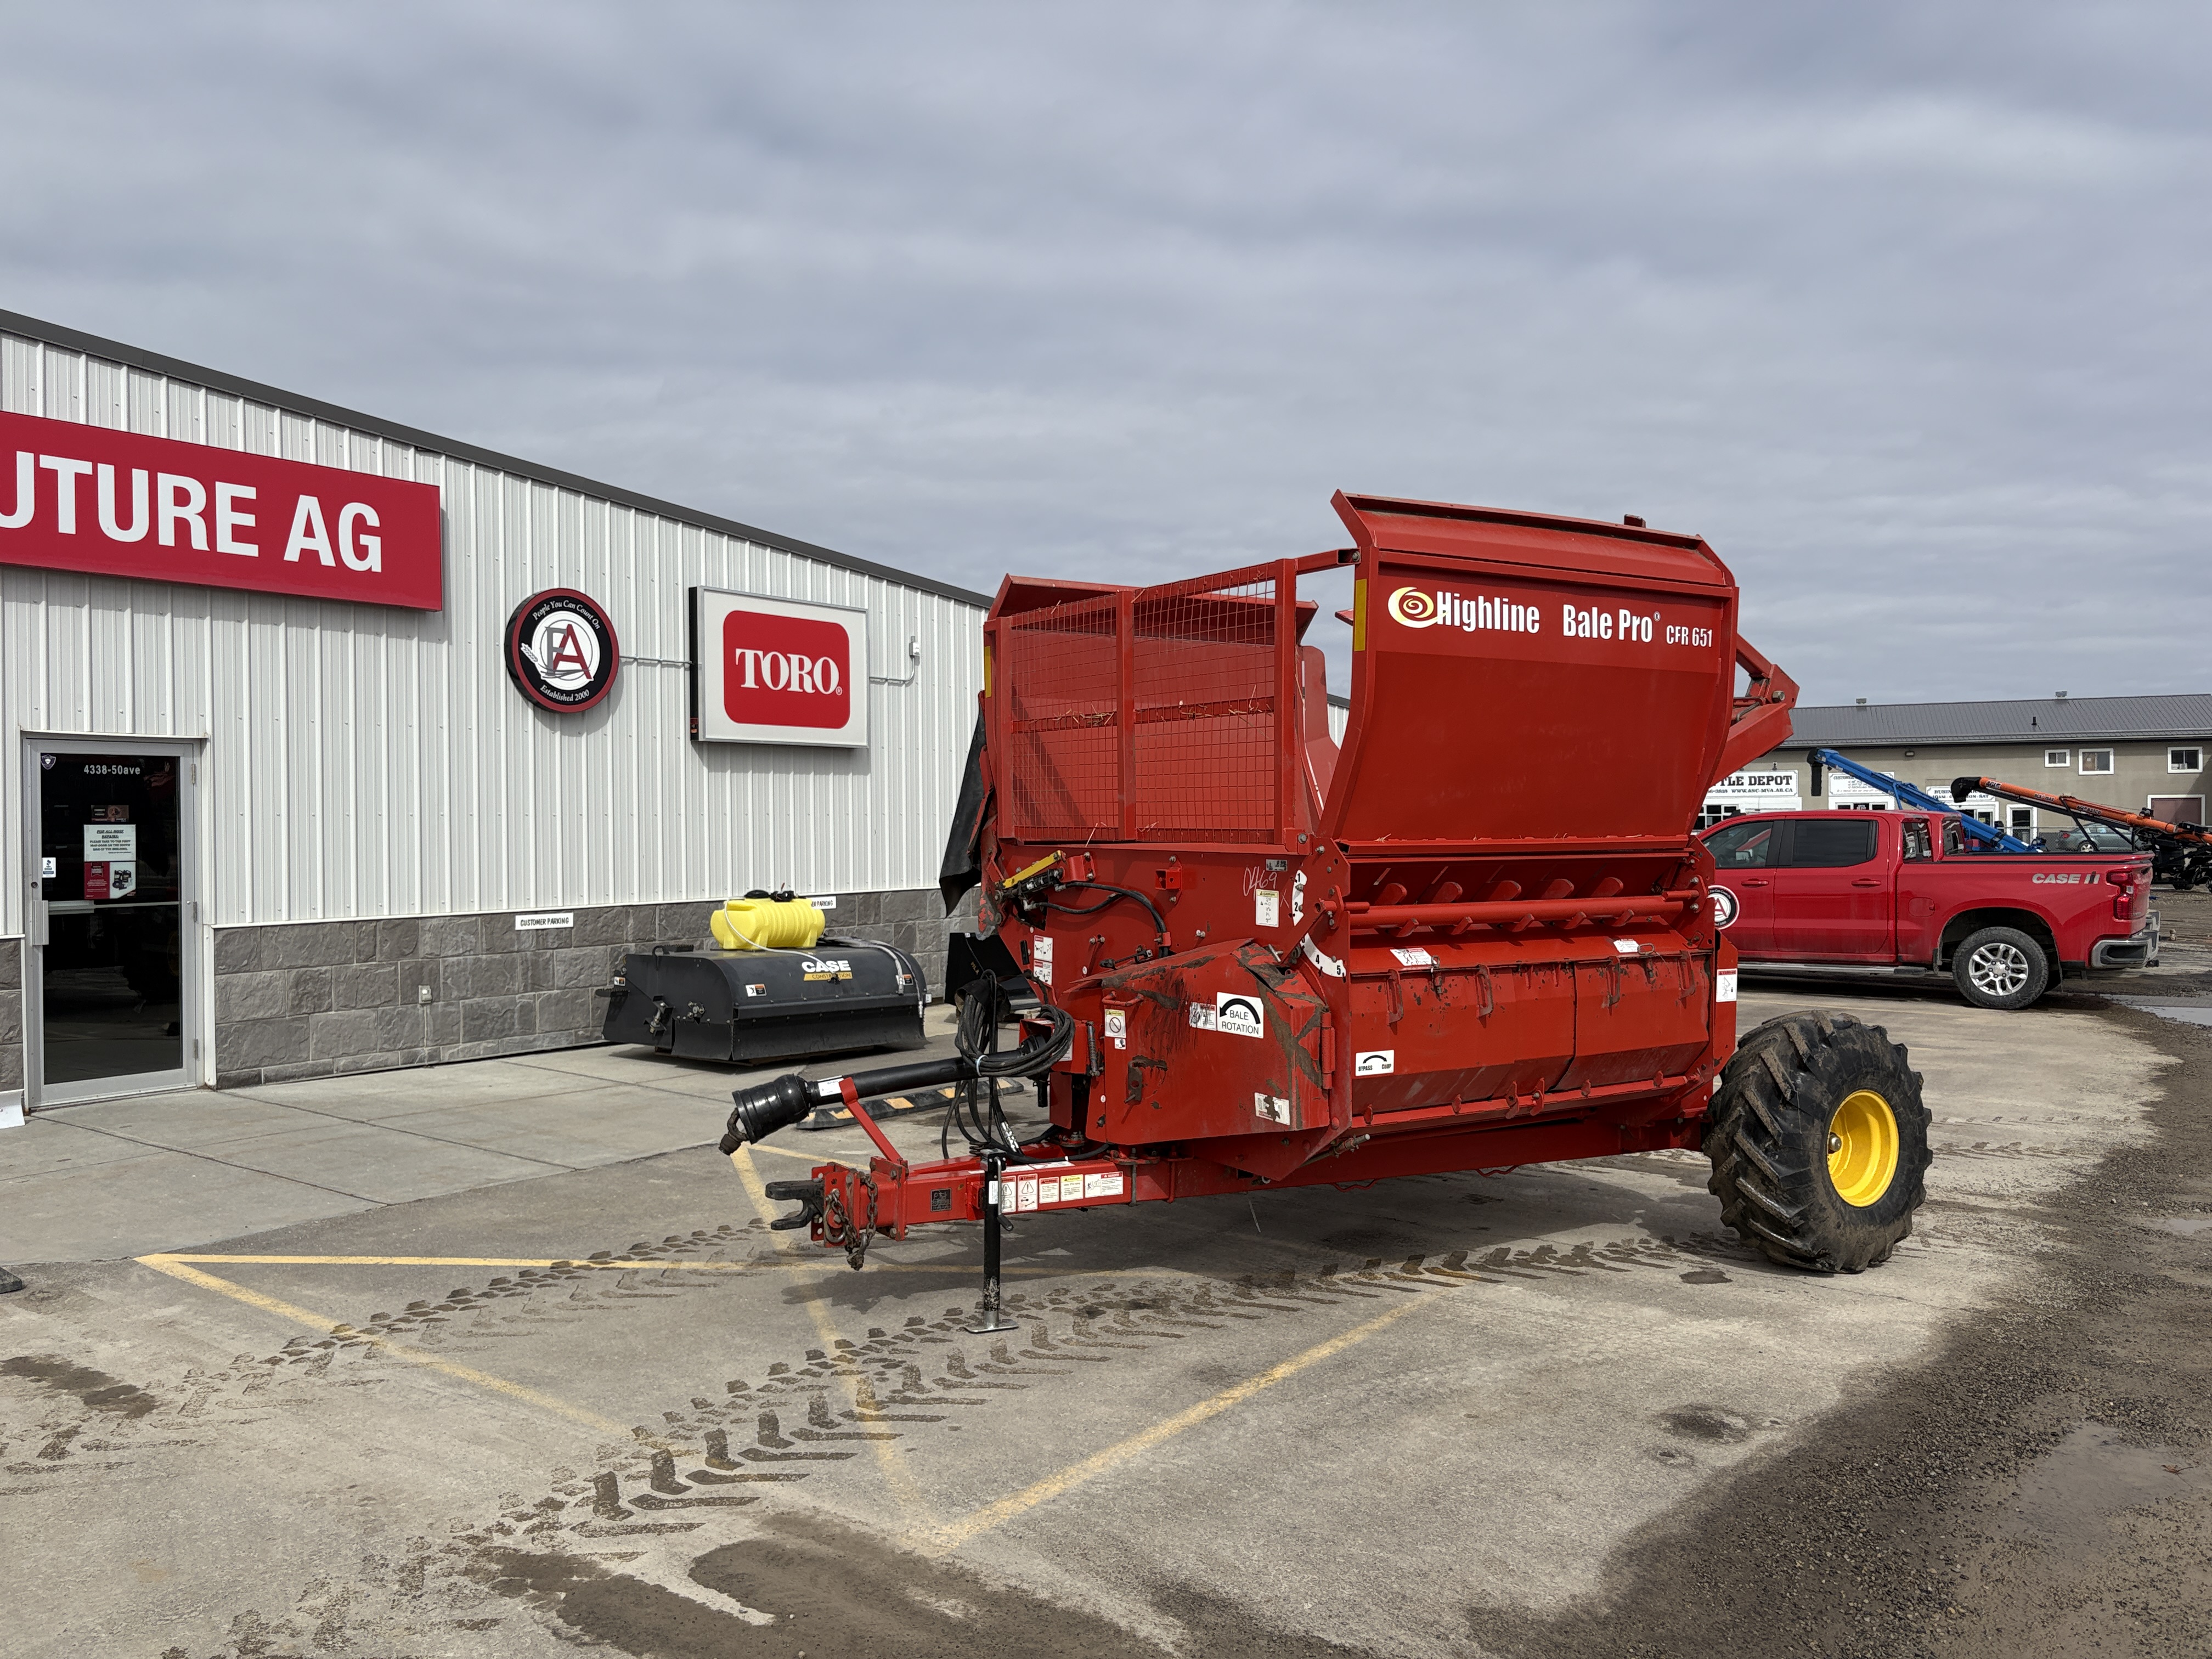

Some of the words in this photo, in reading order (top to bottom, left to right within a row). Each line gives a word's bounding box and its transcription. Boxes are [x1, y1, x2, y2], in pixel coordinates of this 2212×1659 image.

[283, 494, 382, 573] AG
[532, 603, 550, 621] People
[550, 600, 562, 609] You
[563, 600, 576, 610] Can
[576, 604, 592, 620] Count
[592, 619, 600, 630] On
[1436, 591, 1540, 634] Highline
[1563, 604, 1612, 641] Bale
[1666, 625, 1689, 646] CFR
[1692, 628, 1713, 647] 651
[540, 684, 573, 702] Established
[574, 689, 590, 701] 2000
[83, 764, 140, 775] 4338-50ave
[1713, 776, 1744, 786] TLE
[1748, 775, 1792, 786] DEPOT
[1297, 872, 1300, 883] 1
[2032, 873, 2081, 884] CASE
[1294, 901, 1298, 912] 2
[520, 918, 546, 927] CUSTOMER
[547, 917, 569, 925] PARKING
[1315, 955, 1319, 964] 4
[802, 960, 851, 972] CASE
[1336, 965, 1341, 975] 5
[1229, 1009, 1249, 1020] BALE
[1222, 1021, 1259, 1035] ROTATION
